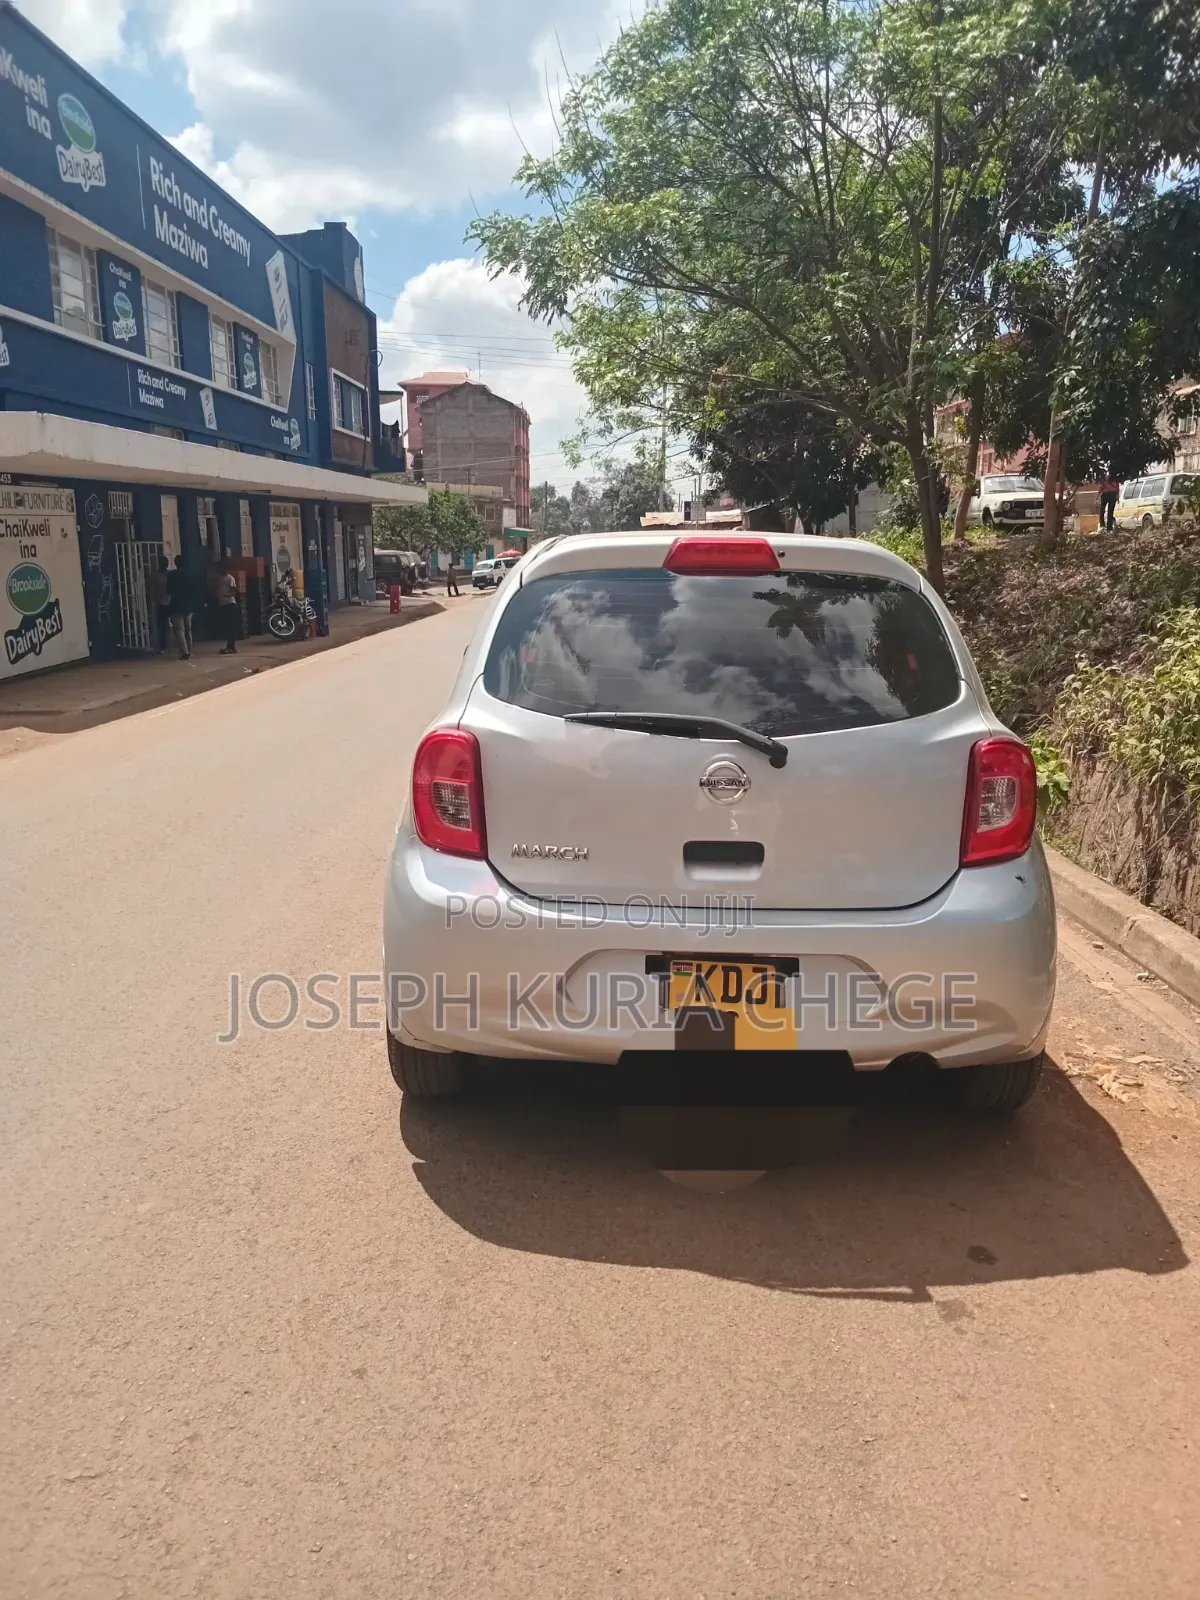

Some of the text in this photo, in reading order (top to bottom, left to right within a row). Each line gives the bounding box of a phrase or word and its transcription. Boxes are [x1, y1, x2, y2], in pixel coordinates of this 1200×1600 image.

[25, 94, 52, 140] ina
[58, 151, 104, 188] DairyBest
[149, 155, 251, 267] Rich and Creamy
[154, 203, 208, 270] Maziwa
[137, 368, 187, 400] Rich and Creamy
[138, 387, 164, 409] Maziwa
[23, 492, 65, 511] FURNITURE
[0, 517, 51, 539] ChaiKweli
[19, 539, 37, 559] ina
[9, 574, 47, 594] Brookside
[5, 605, 61, 662] DairyBest
[705, 778, 746, 789] NISSAN
[511, 843, 589, 861] MARCH
